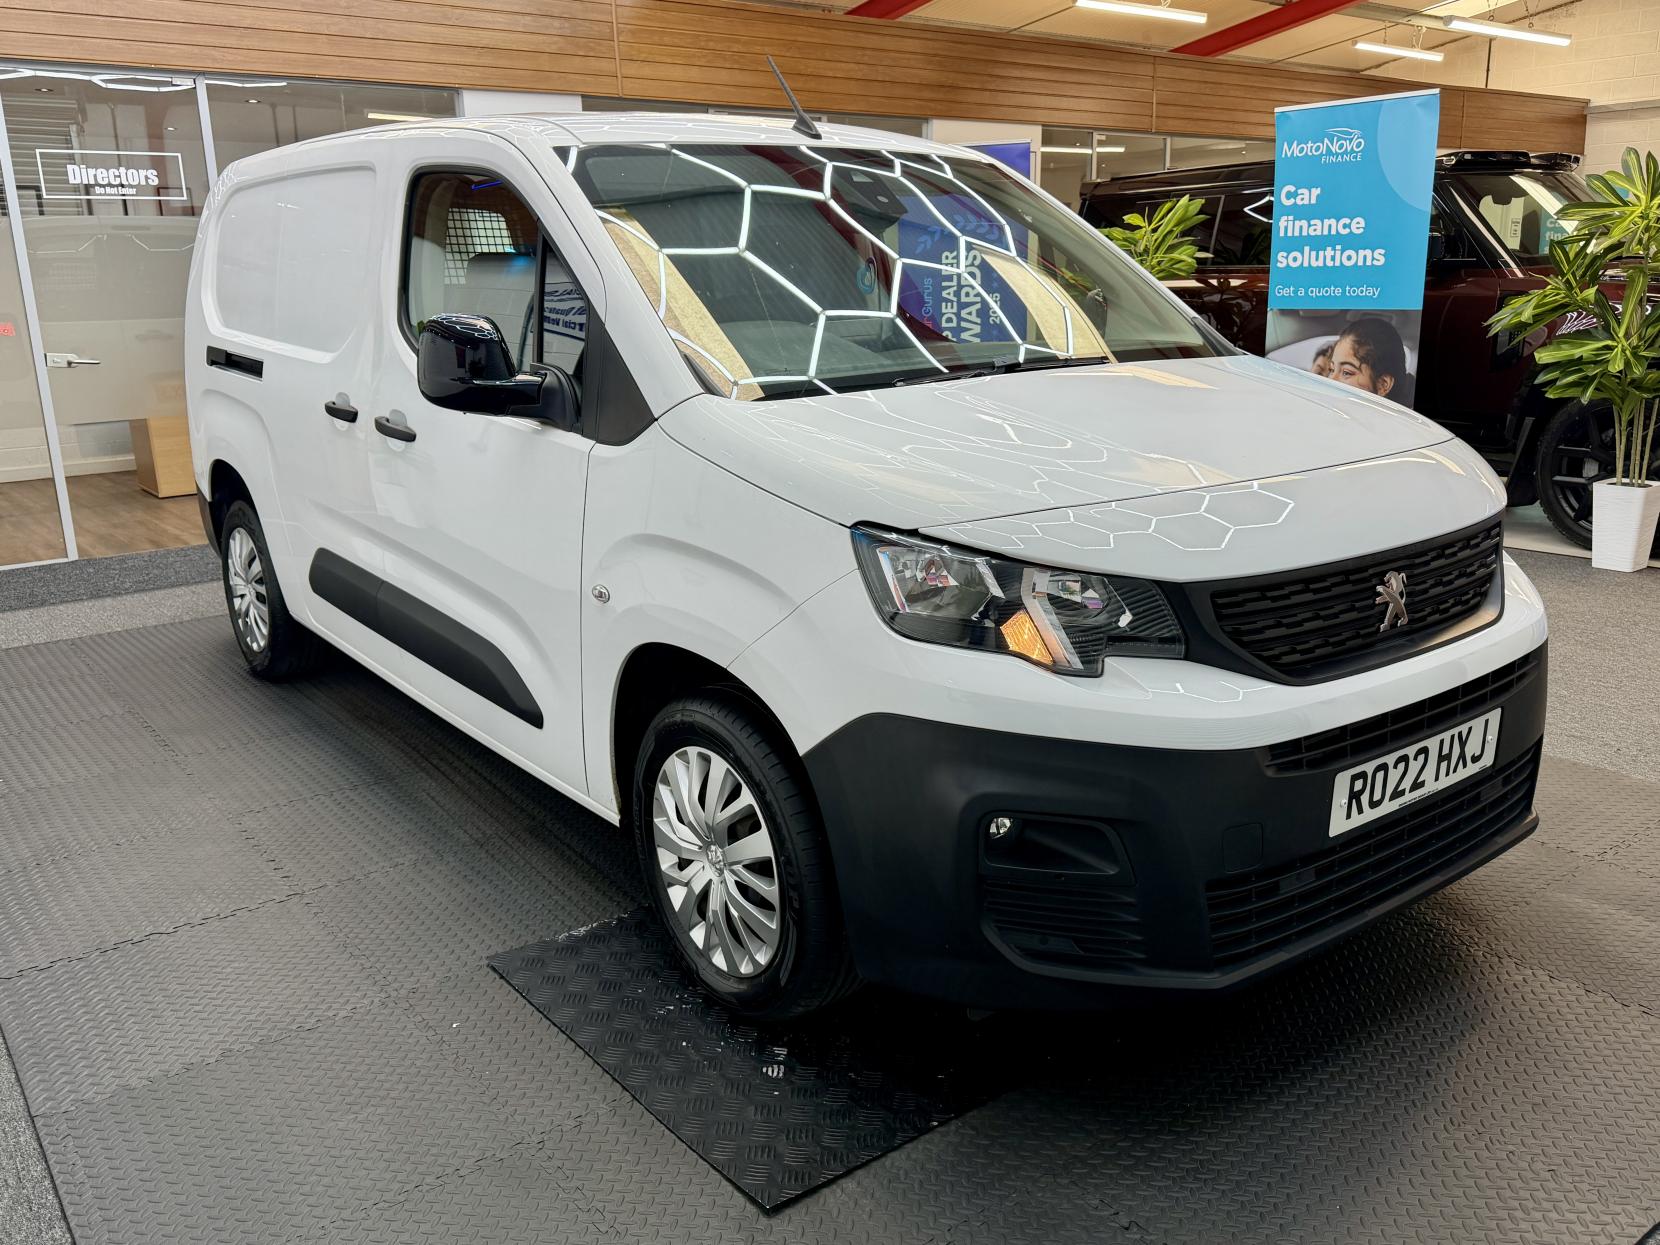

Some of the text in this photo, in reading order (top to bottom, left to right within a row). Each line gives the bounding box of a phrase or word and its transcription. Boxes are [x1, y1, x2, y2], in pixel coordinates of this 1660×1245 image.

[1282, 134, 1364, 158] MotoNovo
[1322, 152, 1362, 164] FINANCE
[67, 164, 159, 186] Directors
[95, 186, 137, 195] Do Not Enter
[1281, 185, 1320, 206] Car
[1279, 215, 1365, 237] finance
[1277, 245, 1385, 268] solutions
[941, 250, 957, 328] DEALER
[960, 250, 982, 343] WARDS
[1275, 284, 1381, 299] Get a quote today
[921, 278, 932, 329] rGurus
[1346, 718, 1489, 820] RO22 HXJ
